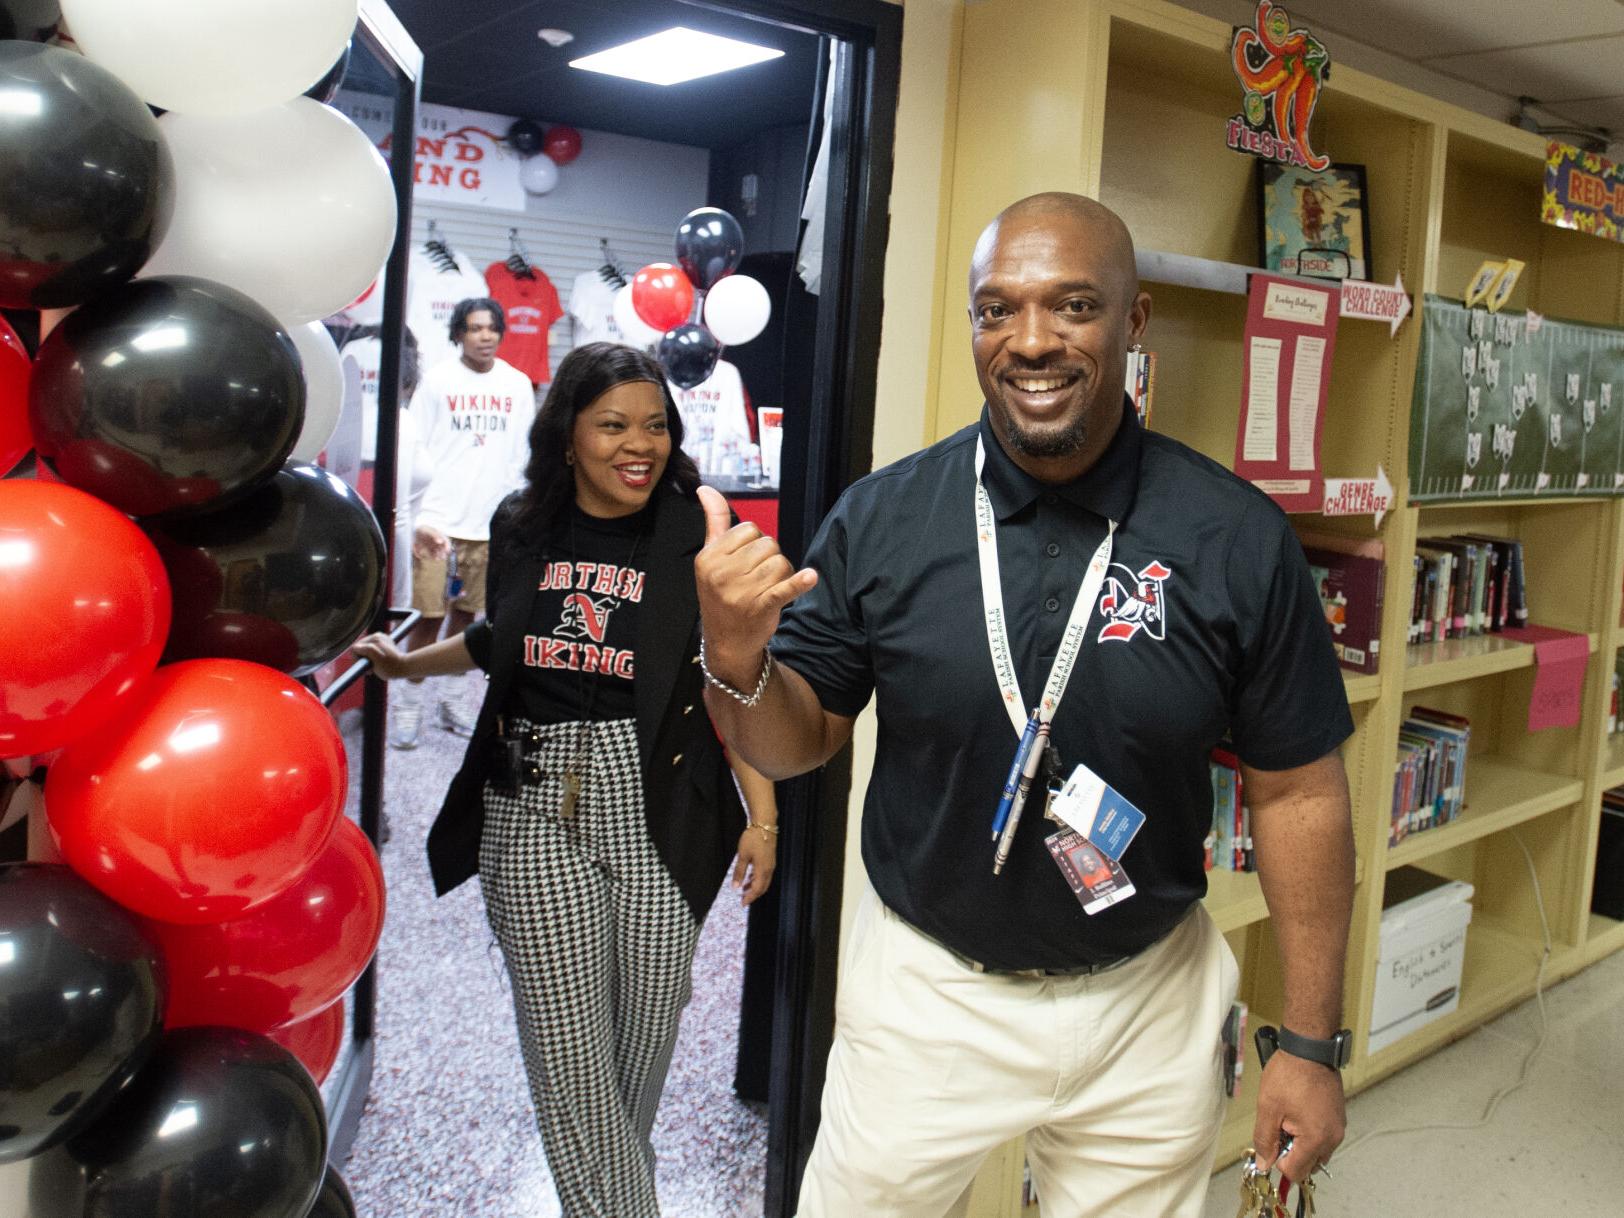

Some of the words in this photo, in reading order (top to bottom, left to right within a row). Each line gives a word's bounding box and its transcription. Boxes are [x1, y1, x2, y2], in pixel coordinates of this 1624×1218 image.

[1342, 285, 1372, 301] WORD
[1373, 287, 1403, 304] COUNT
[1345, 299, 1400, 317] CHALLENGE
[450, 415, 507, 430] NATION
[1325, 497, 1387, 513] CHALLENGE
[1048, 624, 1078, 695] LAFAYETTE
